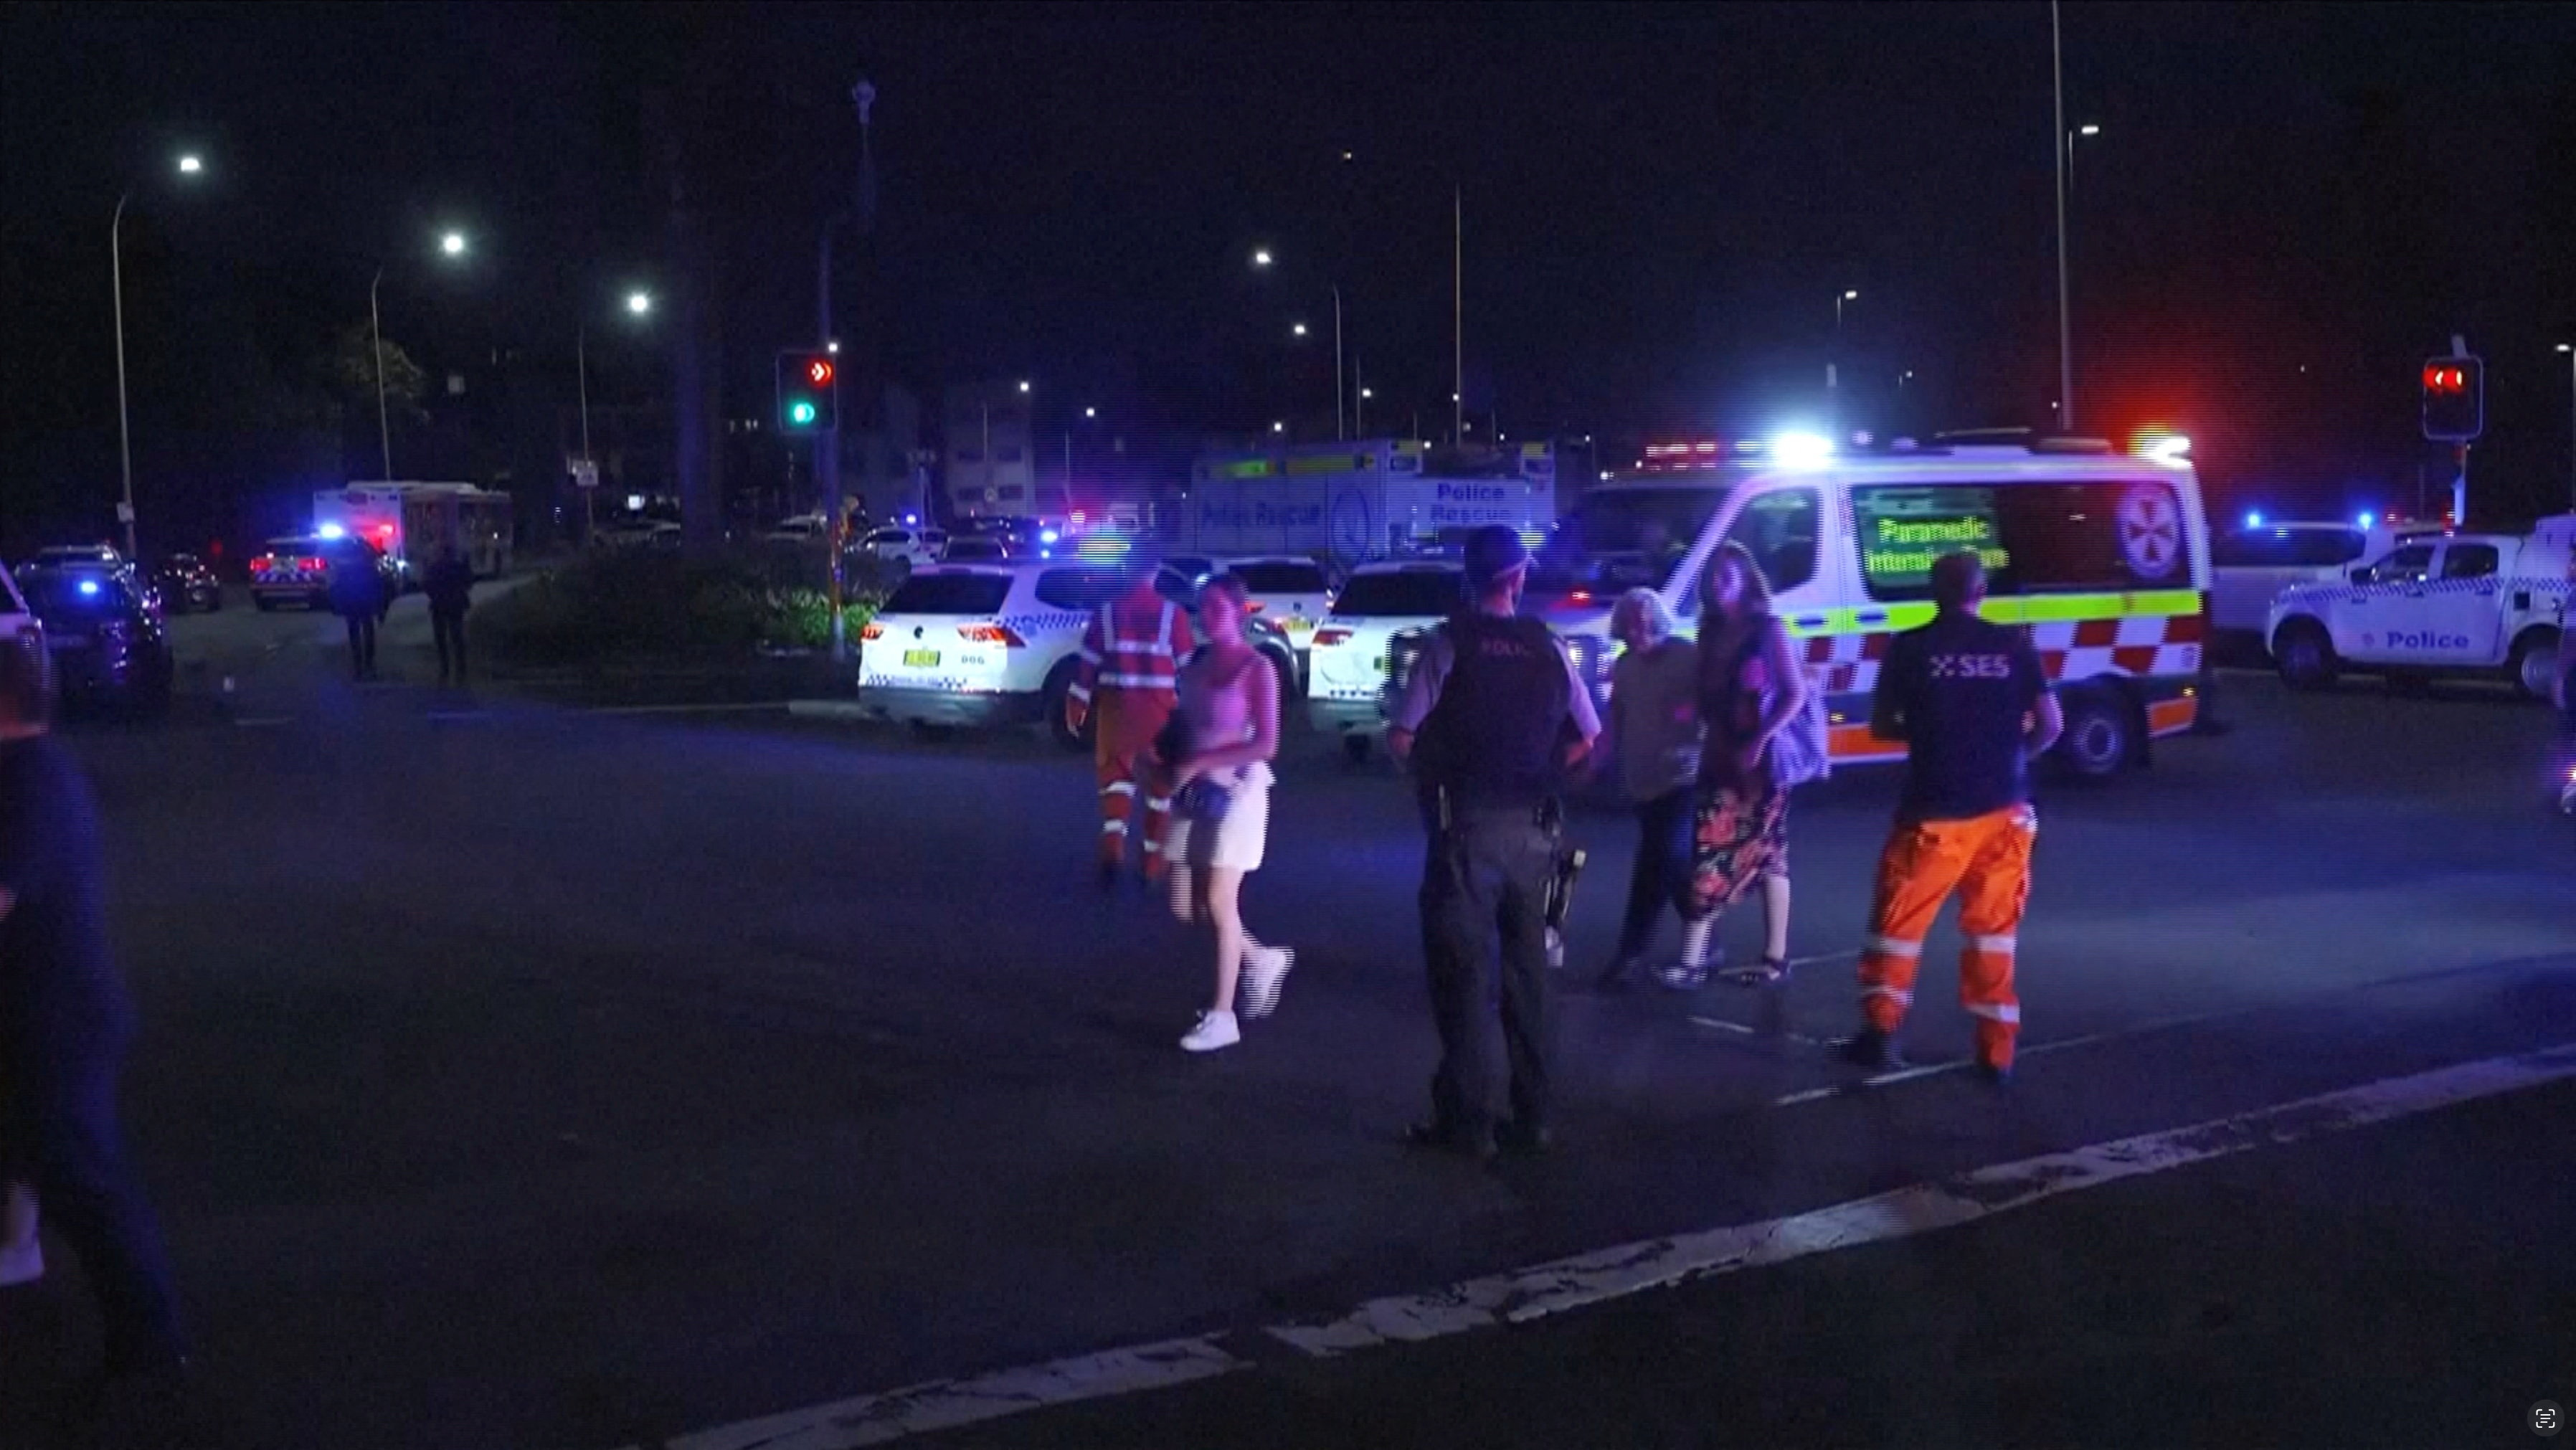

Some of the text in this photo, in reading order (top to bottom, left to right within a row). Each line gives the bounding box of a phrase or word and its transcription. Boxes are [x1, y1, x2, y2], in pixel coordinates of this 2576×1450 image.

[1437, 483, 1505, 501] Police
[1878, 516, 1991, 543] Paramedic
[2386, 630, 2469, 649] Police
[1959, 654, 2010, 678] SES
